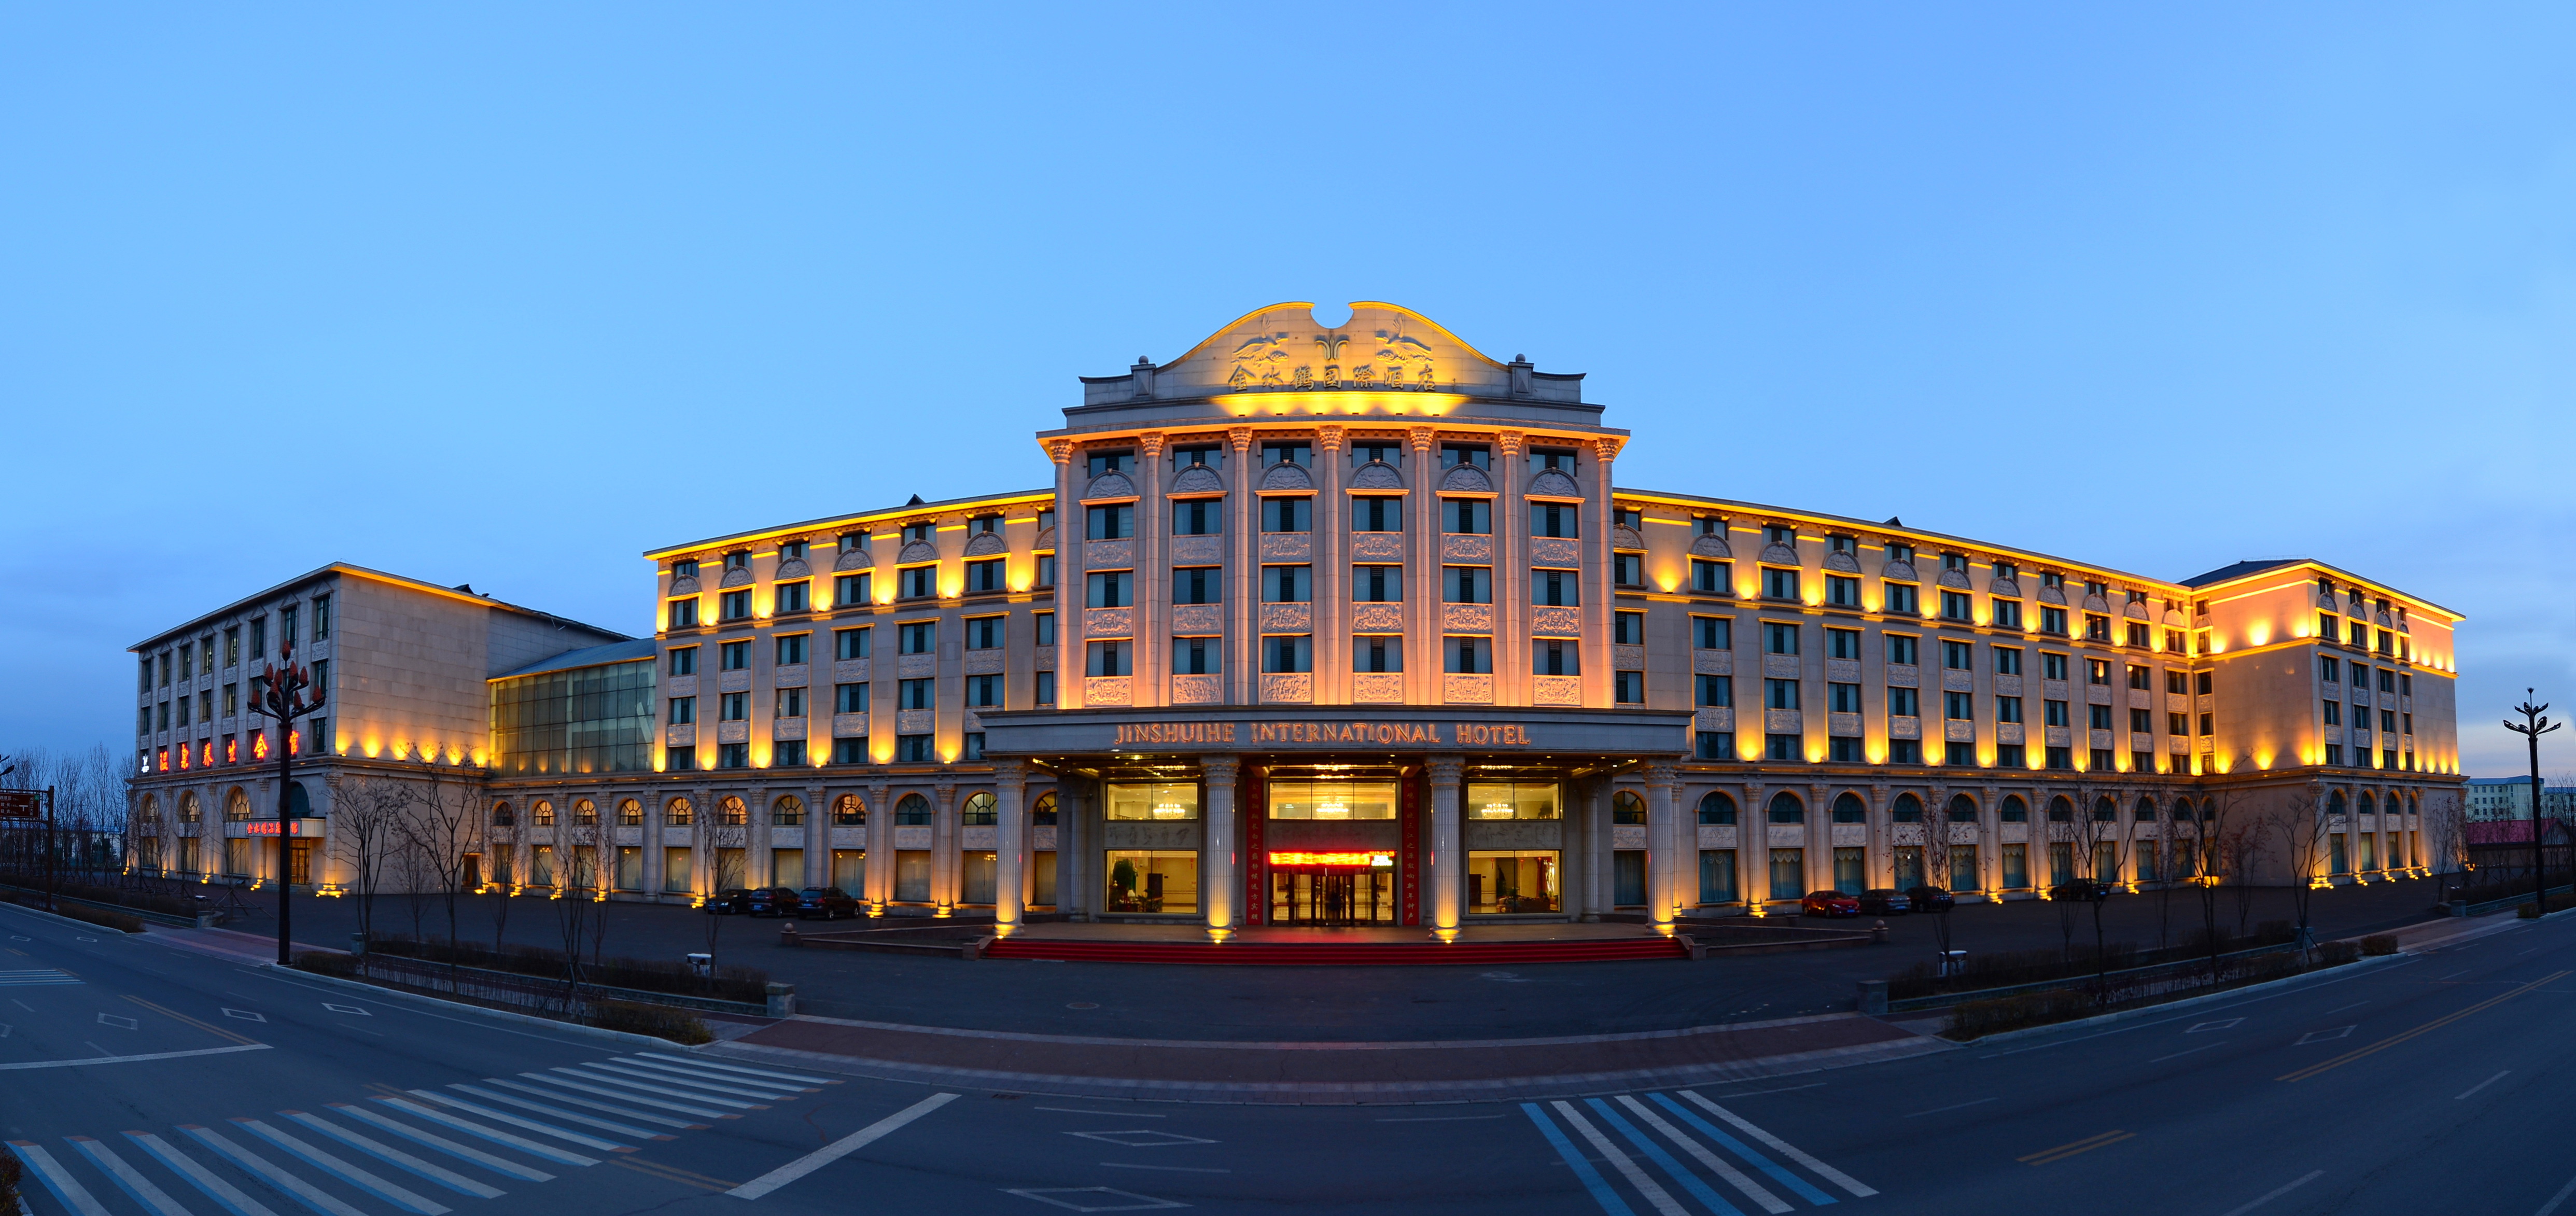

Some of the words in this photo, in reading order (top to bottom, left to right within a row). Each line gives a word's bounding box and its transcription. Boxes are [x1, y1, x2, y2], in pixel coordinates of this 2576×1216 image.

[1115, 724, 1236, 744] JINSHUIHE
[1251, 723, 1441, 744] INTERNATIONAL
[1456, 724, 1532, 745] HOTEL
